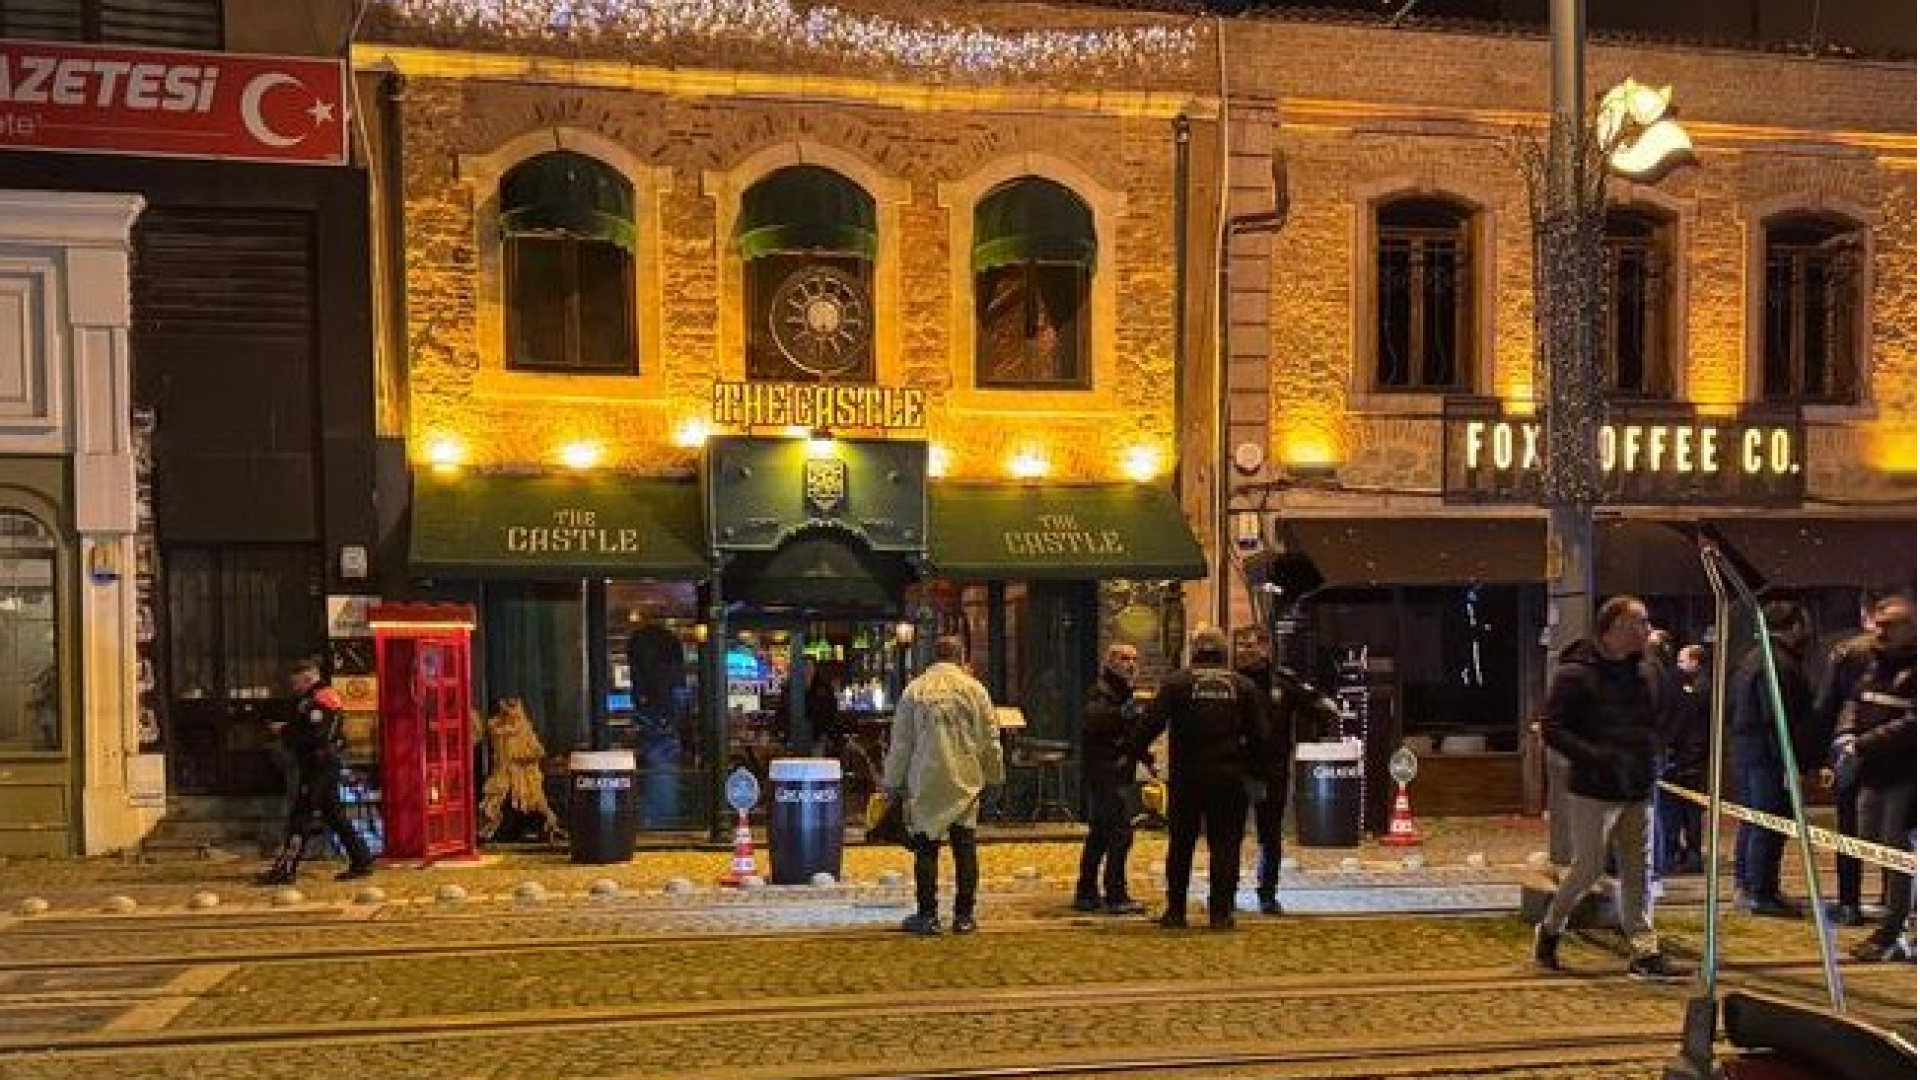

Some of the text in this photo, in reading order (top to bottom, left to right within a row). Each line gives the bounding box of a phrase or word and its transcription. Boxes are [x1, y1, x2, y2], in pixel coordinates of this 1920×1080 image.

[713, 383, 924, 427] THE CASTLE
[1467, 422, 1800, 474] FOX OFFEE CO.
[507, 509, 638, 553] THE CASTLE
[1004, 531, 1125, 554] CASTLE
